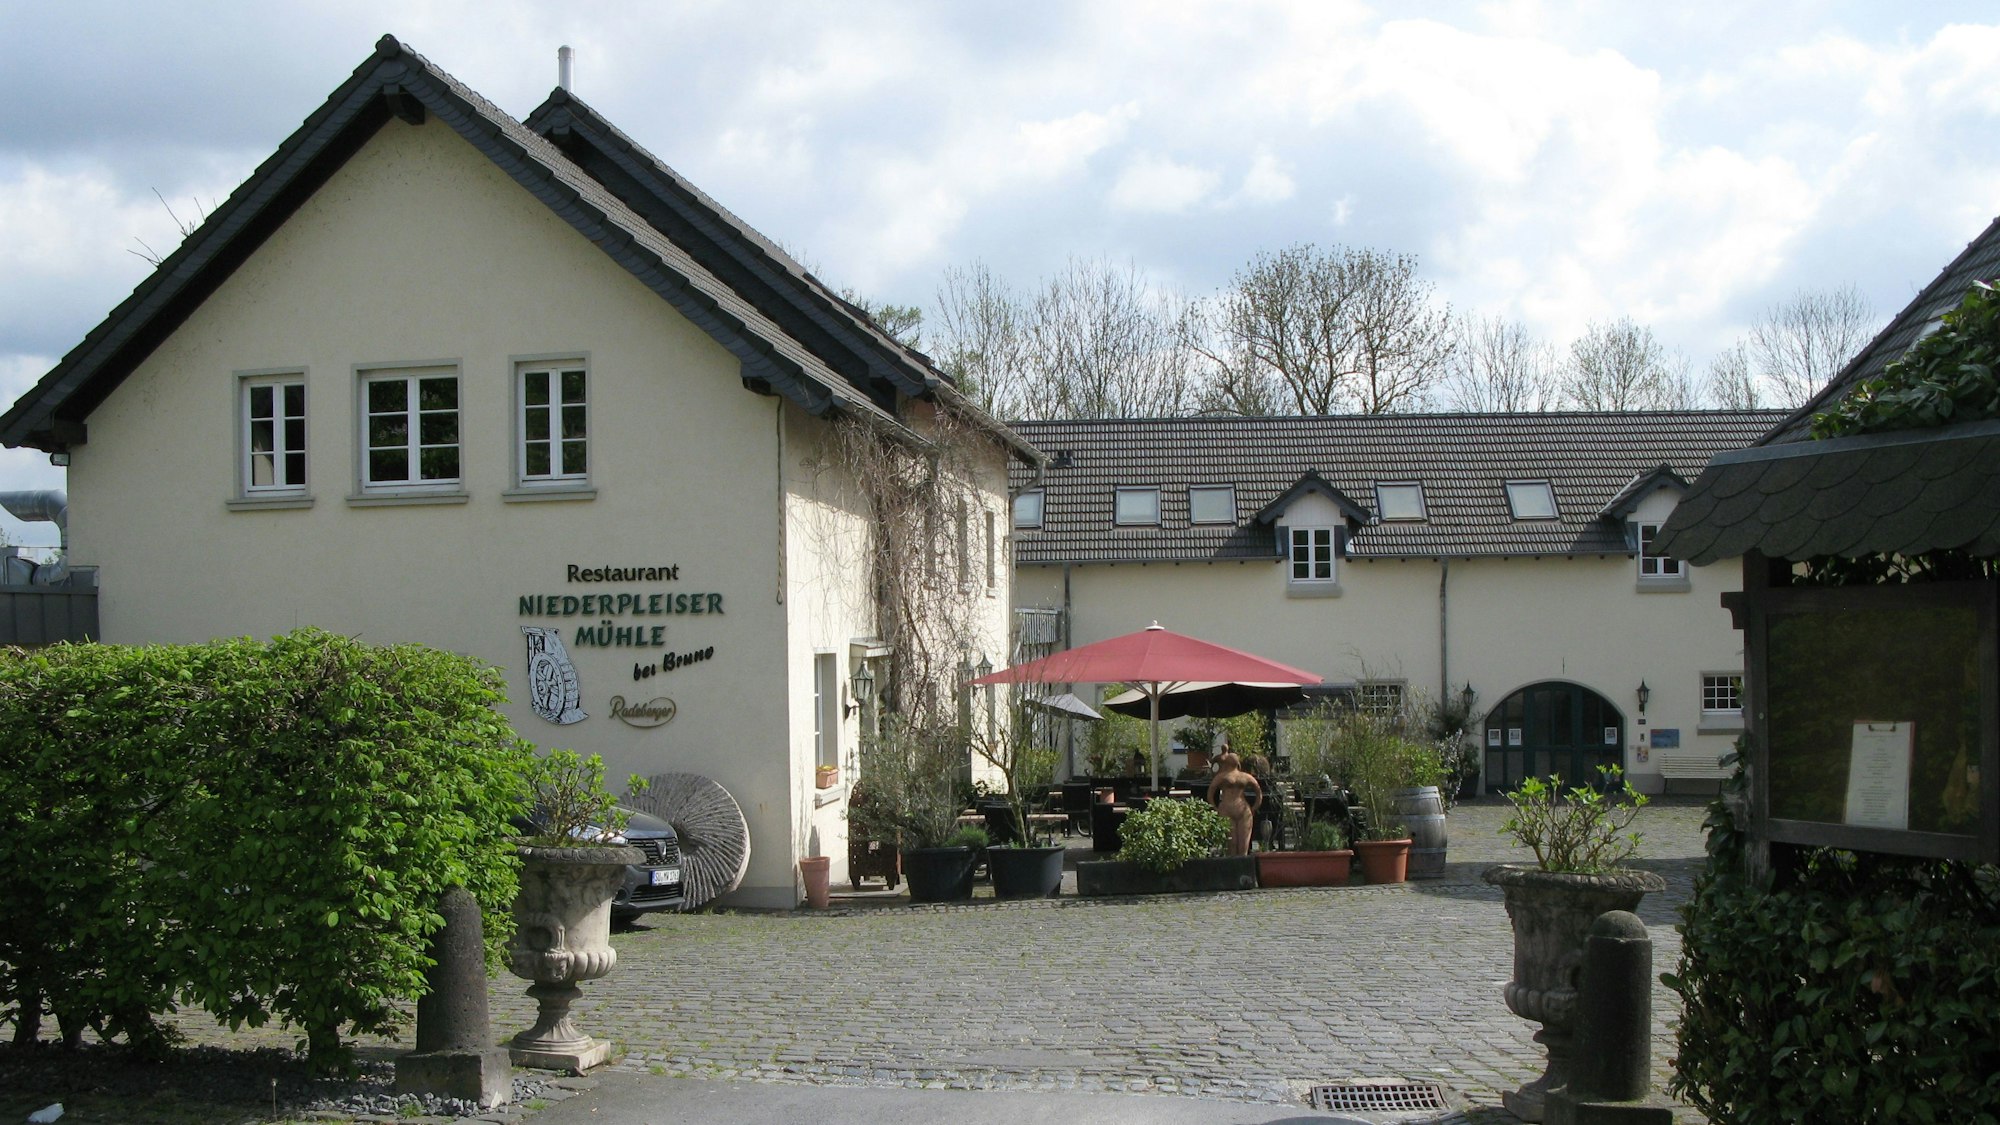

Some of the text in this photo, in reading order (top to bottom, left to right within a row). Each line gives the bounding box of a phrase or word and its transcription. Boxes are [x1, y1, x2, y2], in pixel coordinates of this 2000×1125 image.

[567, 563, 679, 583] Restaurant
[519, 593, 724, 615] NIEDERPLEISER
[575, 620, 666, 646] MÜHLE
[633, 646, 714, 681] bei Bruno
[609, 696, 676, 728] Radeberger
